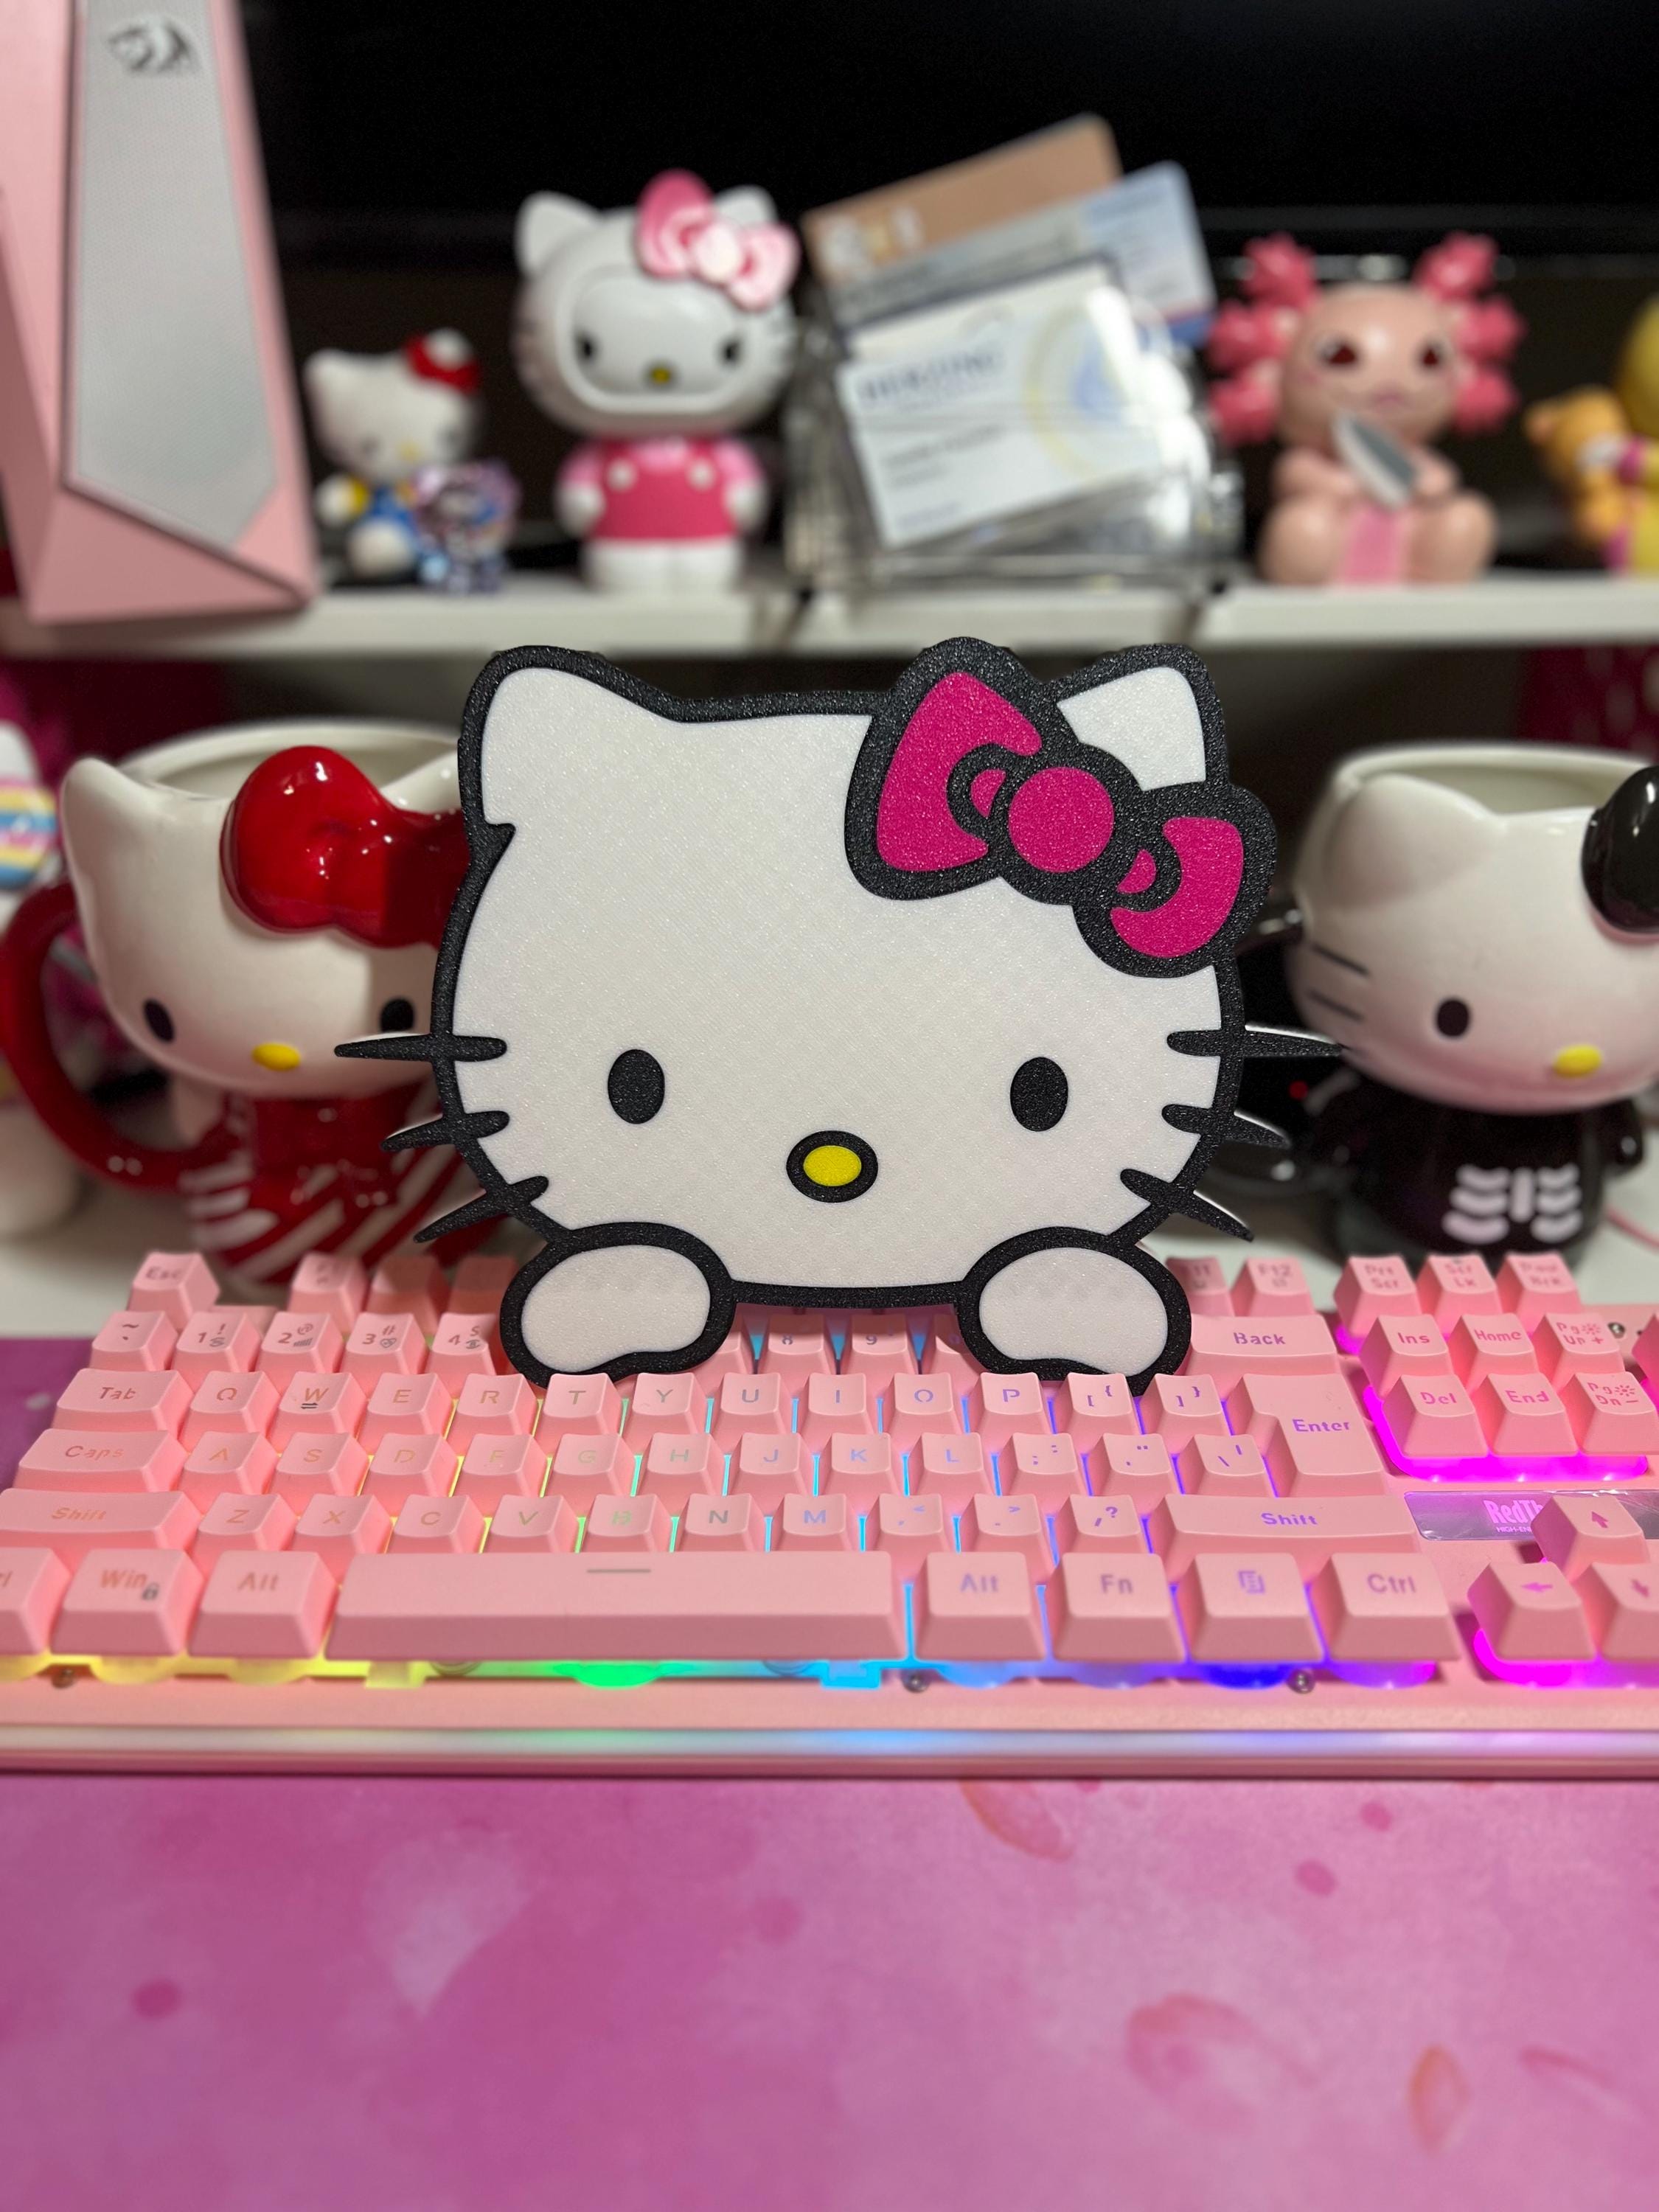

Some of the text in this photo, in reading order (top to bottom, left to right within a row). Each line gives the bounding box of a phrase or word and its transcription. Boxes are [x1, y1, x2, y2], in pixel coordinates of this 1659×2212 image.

[1556, 1322, 1580, 1334] Pg
[198, 1332, 206, 1343] 1
[278, 1332, 292, 1344] 2
[362, 1333, 376, 1345] 3
[865, 1334, 877, 1346] 9
[1233, 1332, 1286, 1345] Back
[1398, 1332, 1430, 1344] Ins
[1474, 1329, 1523, 1342] Home
[99, 1387, 136, 1400] Tab
[216, 1387, 237, 1401] Q
[305, 1387, 330, 1402] W
[1002, 1388, 1020, 1402] P
[1587, 1382, 1613, 1394] Pg
[392, 1389, 412, 1403] E
[480, 1391, 501, 1404] R
[568, 1390, 587, 1405] T
[655, 1389, 674, 1403] Y
[742, 1389, 760, 1403] U
[835, 1389, 841, 1403] I
[914, 1389, 934, 1402] O
[1419, 1391, 1458, 1405] Del
[1505, 1390, 1551, 1404] End
[1595, 1394, 1622, 1406] Dn
[1291, 1418, 1351, 1433] Enter
[64, 1444, 125, 1461] Caps
[208, 1447, 229, 1461] A
[303, 1449, 323, 1463] S
[394, 1450, 416, 1464] D
[489, 1450, 506, 1464] F
[577, 1450, 597, 1464] G
[669, 1448, 689, 1463] H
[762, 1448, 779, 1463] J
[850, 1448, 868, 1462] K
[945, 1448, 959, 1463] L
[51, 1507, 107, 1521] Shift
[226, 1509, 250, 1524] Z
[323, 1510, 347, 1525] X
[420, 1511, 441, 1526] C
[518, 1510, 539, 1526] V
[611, 1510, 632, 1526] B
[709, 1509, 729, 1524] N
[802, 1509, 827, 1524] M
[1483, 1500, 1544, 1523] RedTh
[1261, 1512, 1318, 1526] Shift
[100, 1568, 148, 1589] Win
[237, 1571, 280, 1592] Alt
[961, 1573, 1000, 1593] Alt
[1100, 1573, 1134, 1594] Fn
[1367, 1573, 1417, 1593] Ctrl
